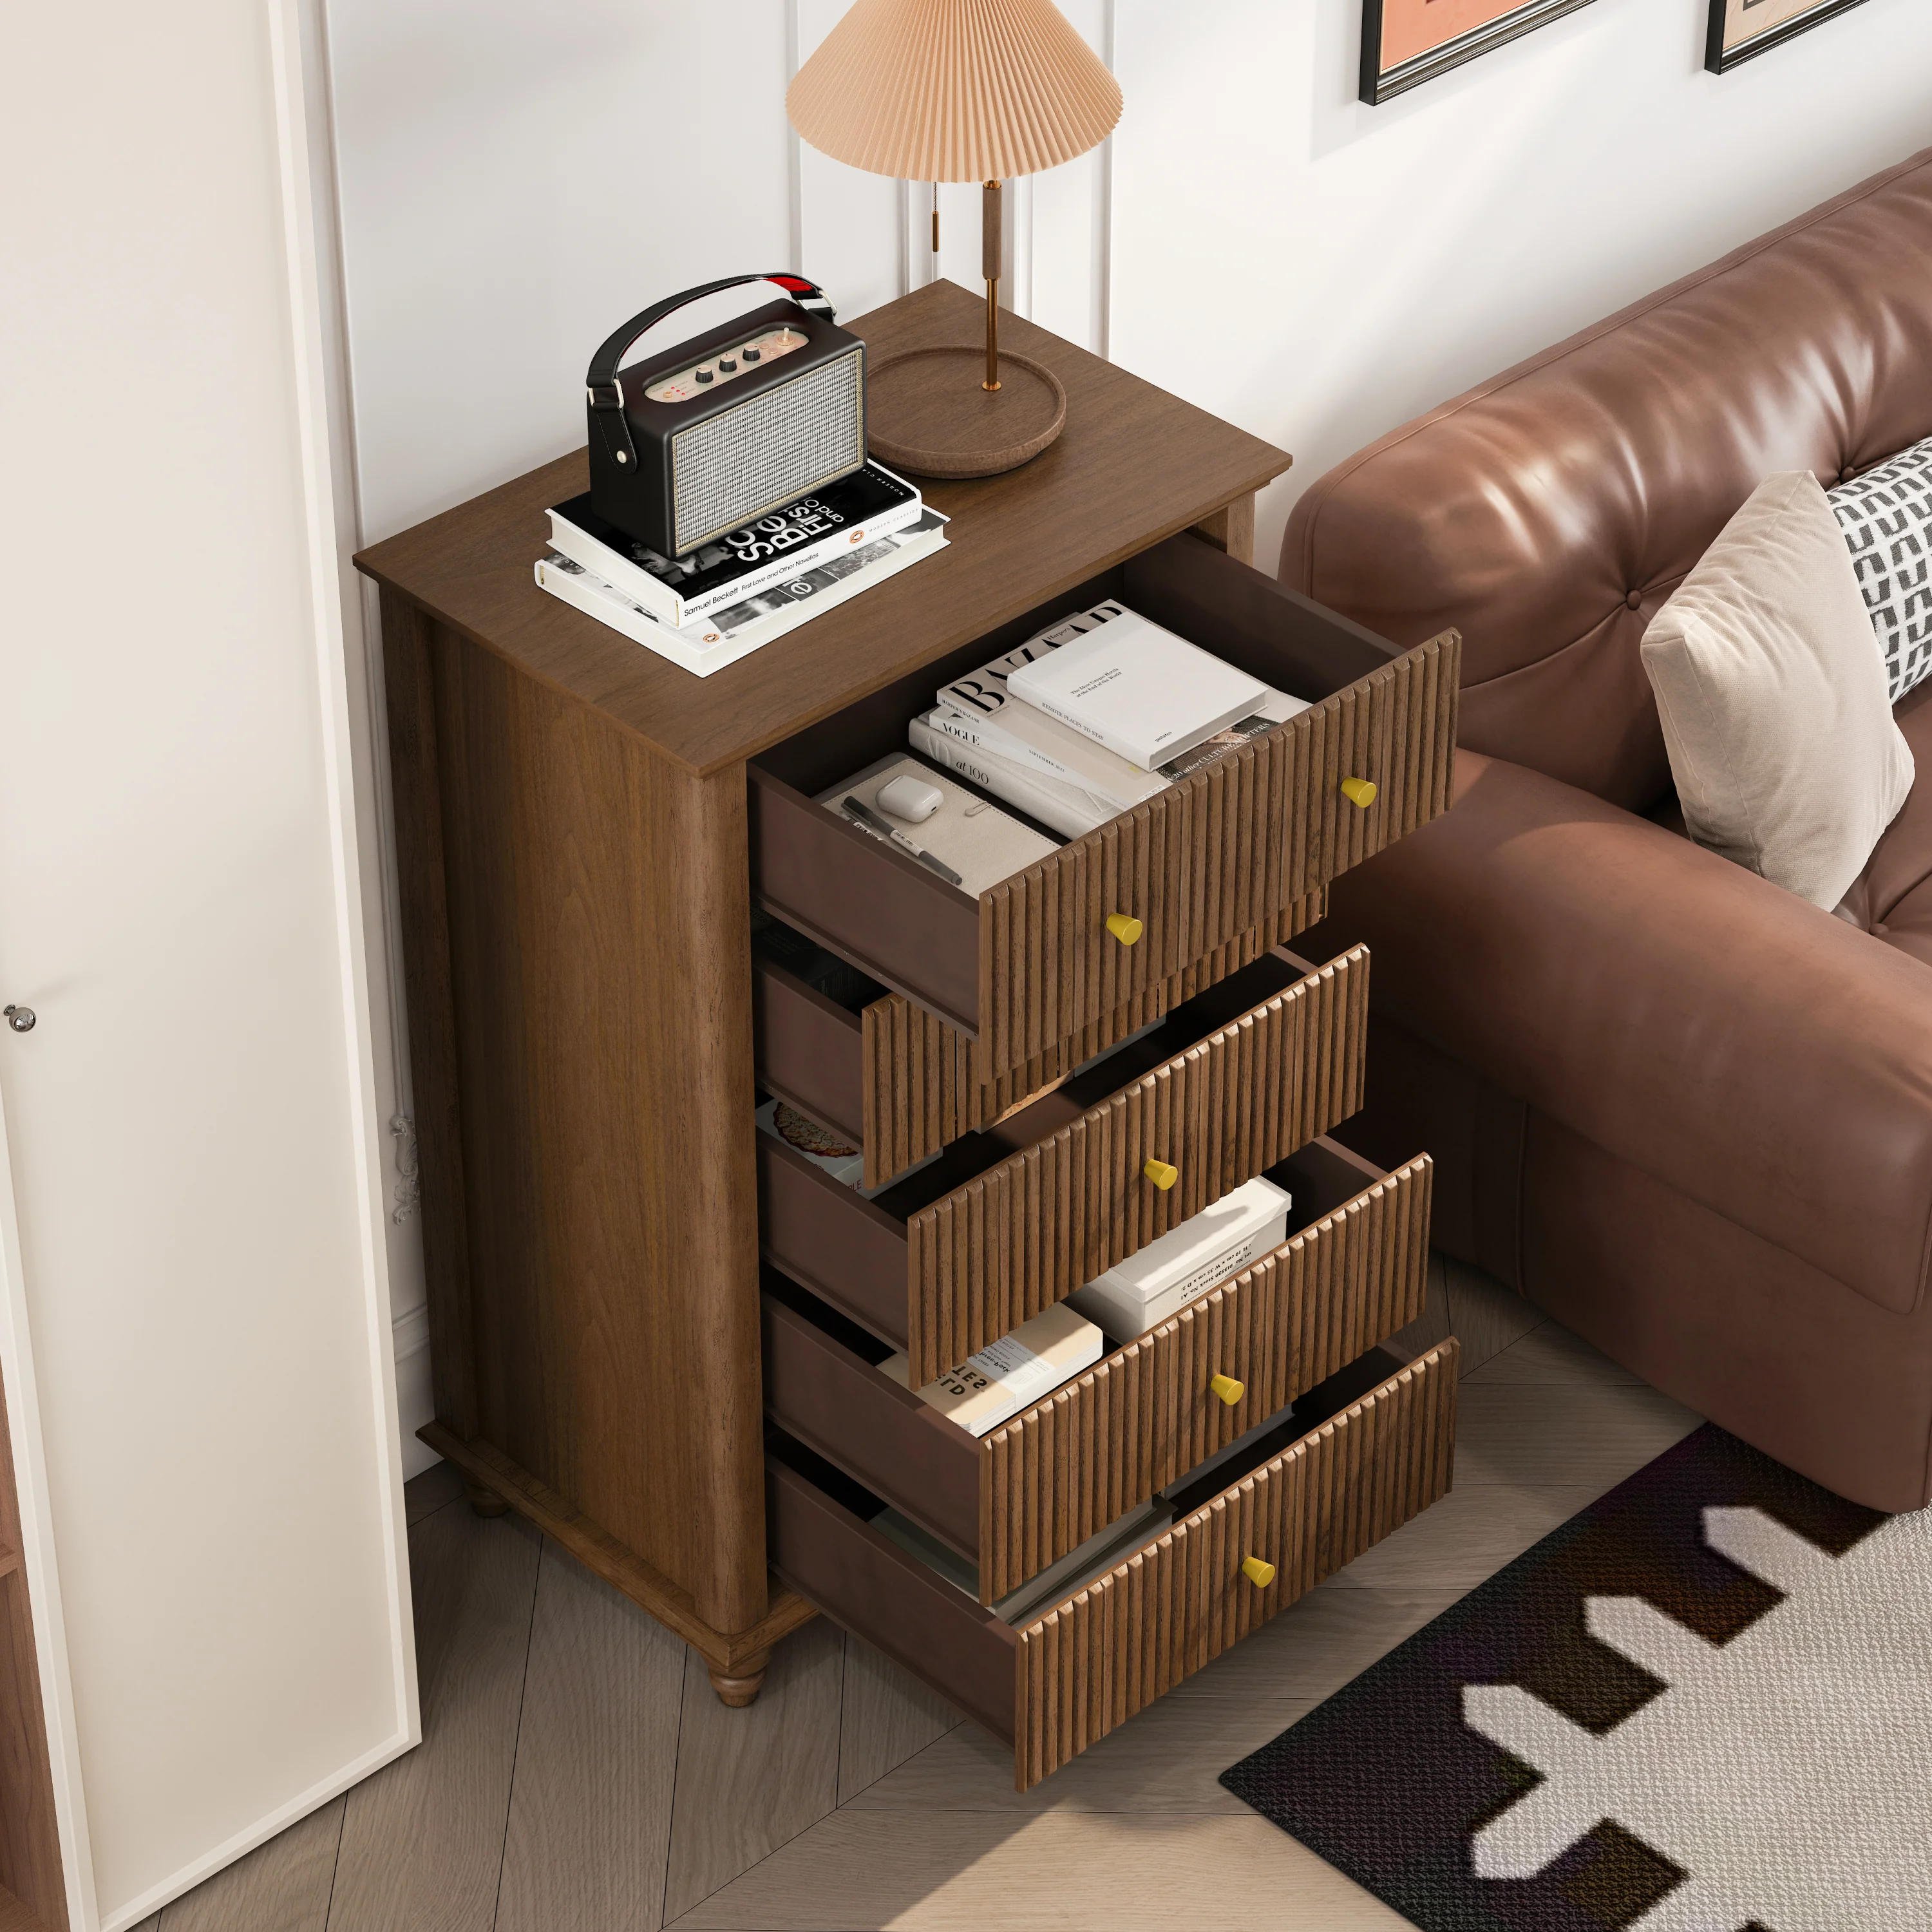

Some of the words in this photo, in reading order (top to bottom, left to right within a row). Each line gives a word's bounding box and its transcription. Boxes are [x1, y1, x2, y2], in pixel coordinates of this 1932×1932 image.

[876, 478, 904, 496] MODERN
[814, 506, 844, 523] and
[869, 521, 890, 533] MODERN
[684, 599, 712, 616] Samuel
[712, 587, 739, 604] Beckett
[741, 580, 752, 591] First
[753, 576, 766, 586] Love
[766, 570, 779, 580] and
[779, 564, 795, 574] Other
[795, 553, 819, 567] Novellas
[1046, 627, 1071, 641] Harper's
[1090, 674, 1106, 685] Unique
[1104, 668, 1119, 676] Hotels
[1108, 671, 1122, 680] World
[941, 698, 961, 715] HARPER'S
[961, 711, 980, 724] BAZAAR
[1042, 702, 1063, 717] REMOTE
[1063, 714, 1082, 728] PLACES
[1083, 725, 1092, 734] TO
[1092, 730, 1104, 741] STAY
[943, 723, 980, 746] VOGUE
[924, 735, 951, 767] AD
[956, 760, 967, 772] at
[969, 765, 989, 784] 100
[1173, 770, 1183, 780] 20
[1182, 761, 1199, 774] other
[1198, 743, 1233, 764] CULTURE
[1231, 722, 1271, 749] SHIFTERS
[1028, 750, 1054, 767] SEPTEMBER
[1055, 764, 1065, 773] 2022
[1215, 1264, 1233, 1278] 913530
[1200, 1277, 1214, 1287] Stock
